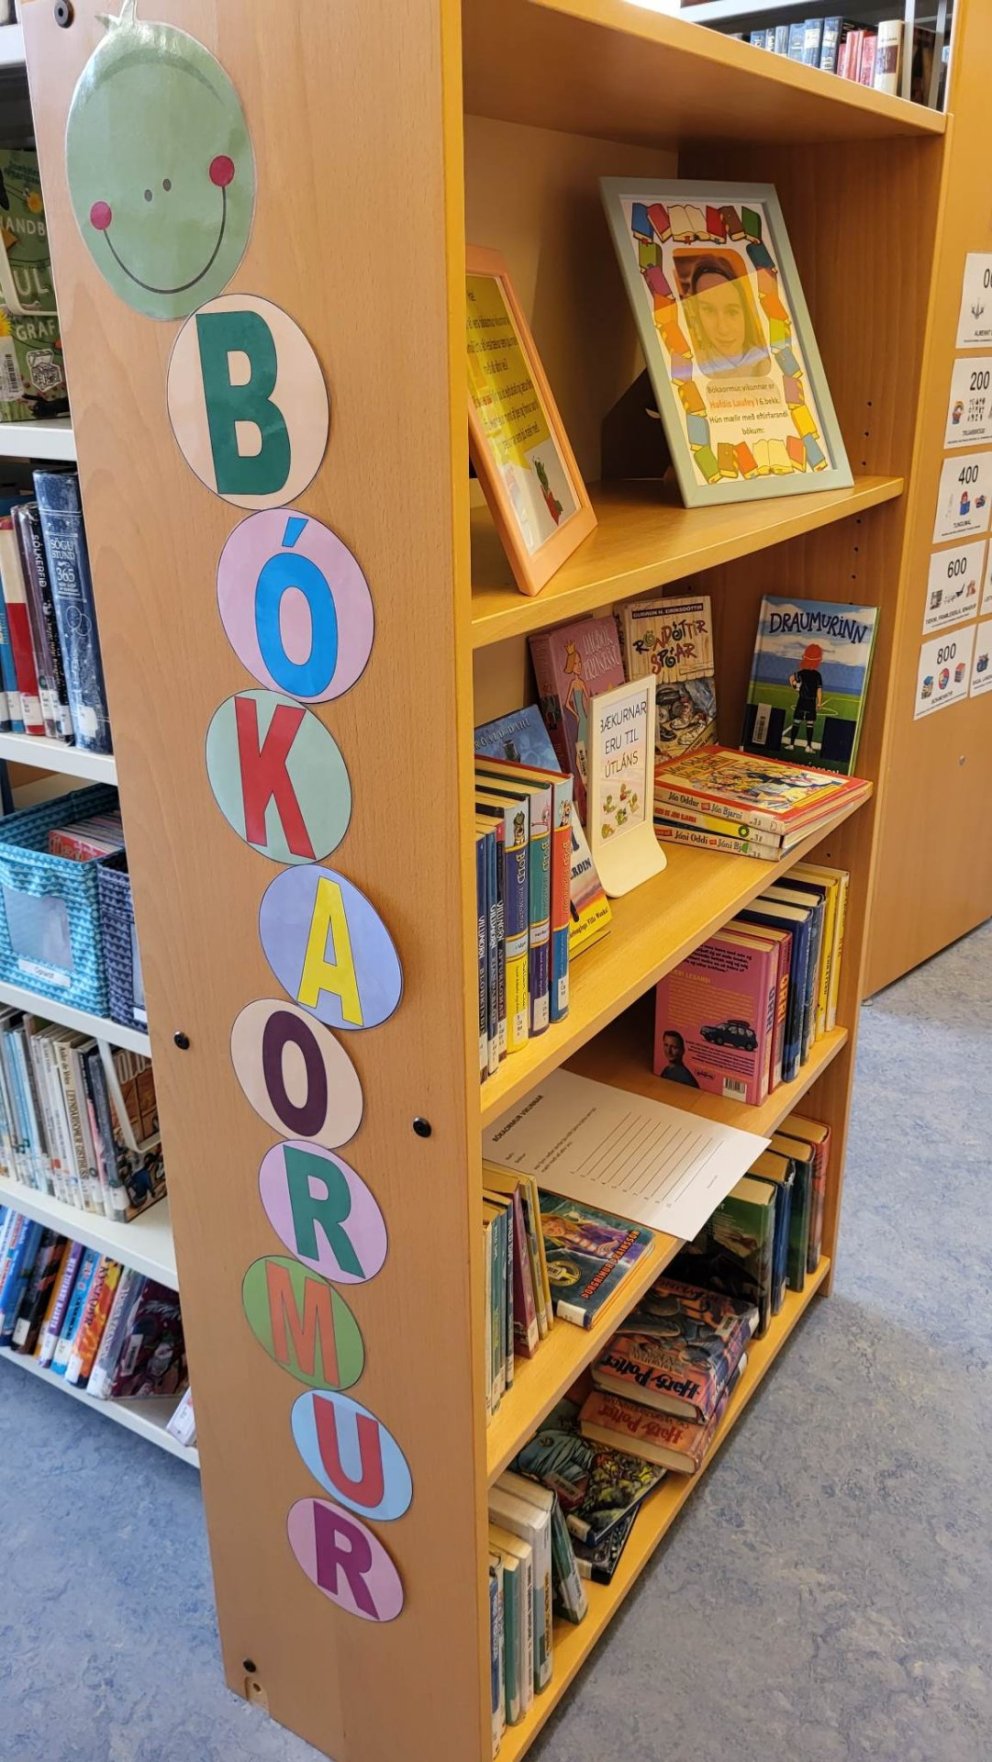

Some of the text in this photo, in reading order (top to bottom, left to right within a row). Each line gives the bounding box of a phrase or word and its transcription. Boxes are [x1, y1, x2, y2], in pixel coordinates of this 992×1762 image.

[970, 371, 990, 392] 200
[958, 465, 978, 485] 400
[56, 567, 76, 583] 365
[947, 556, 967, 579] 600
[936, 642, 957, 665] 800
[605, 728, 639, 755] ERU TIL
[604, 751, 638, 778] ÚTLÁNS
[601, 1354, 702, 1400] Harry Potter
[597, 1405, 640, 1433] Potter
[642, 1421, 684, 1445] Harry
